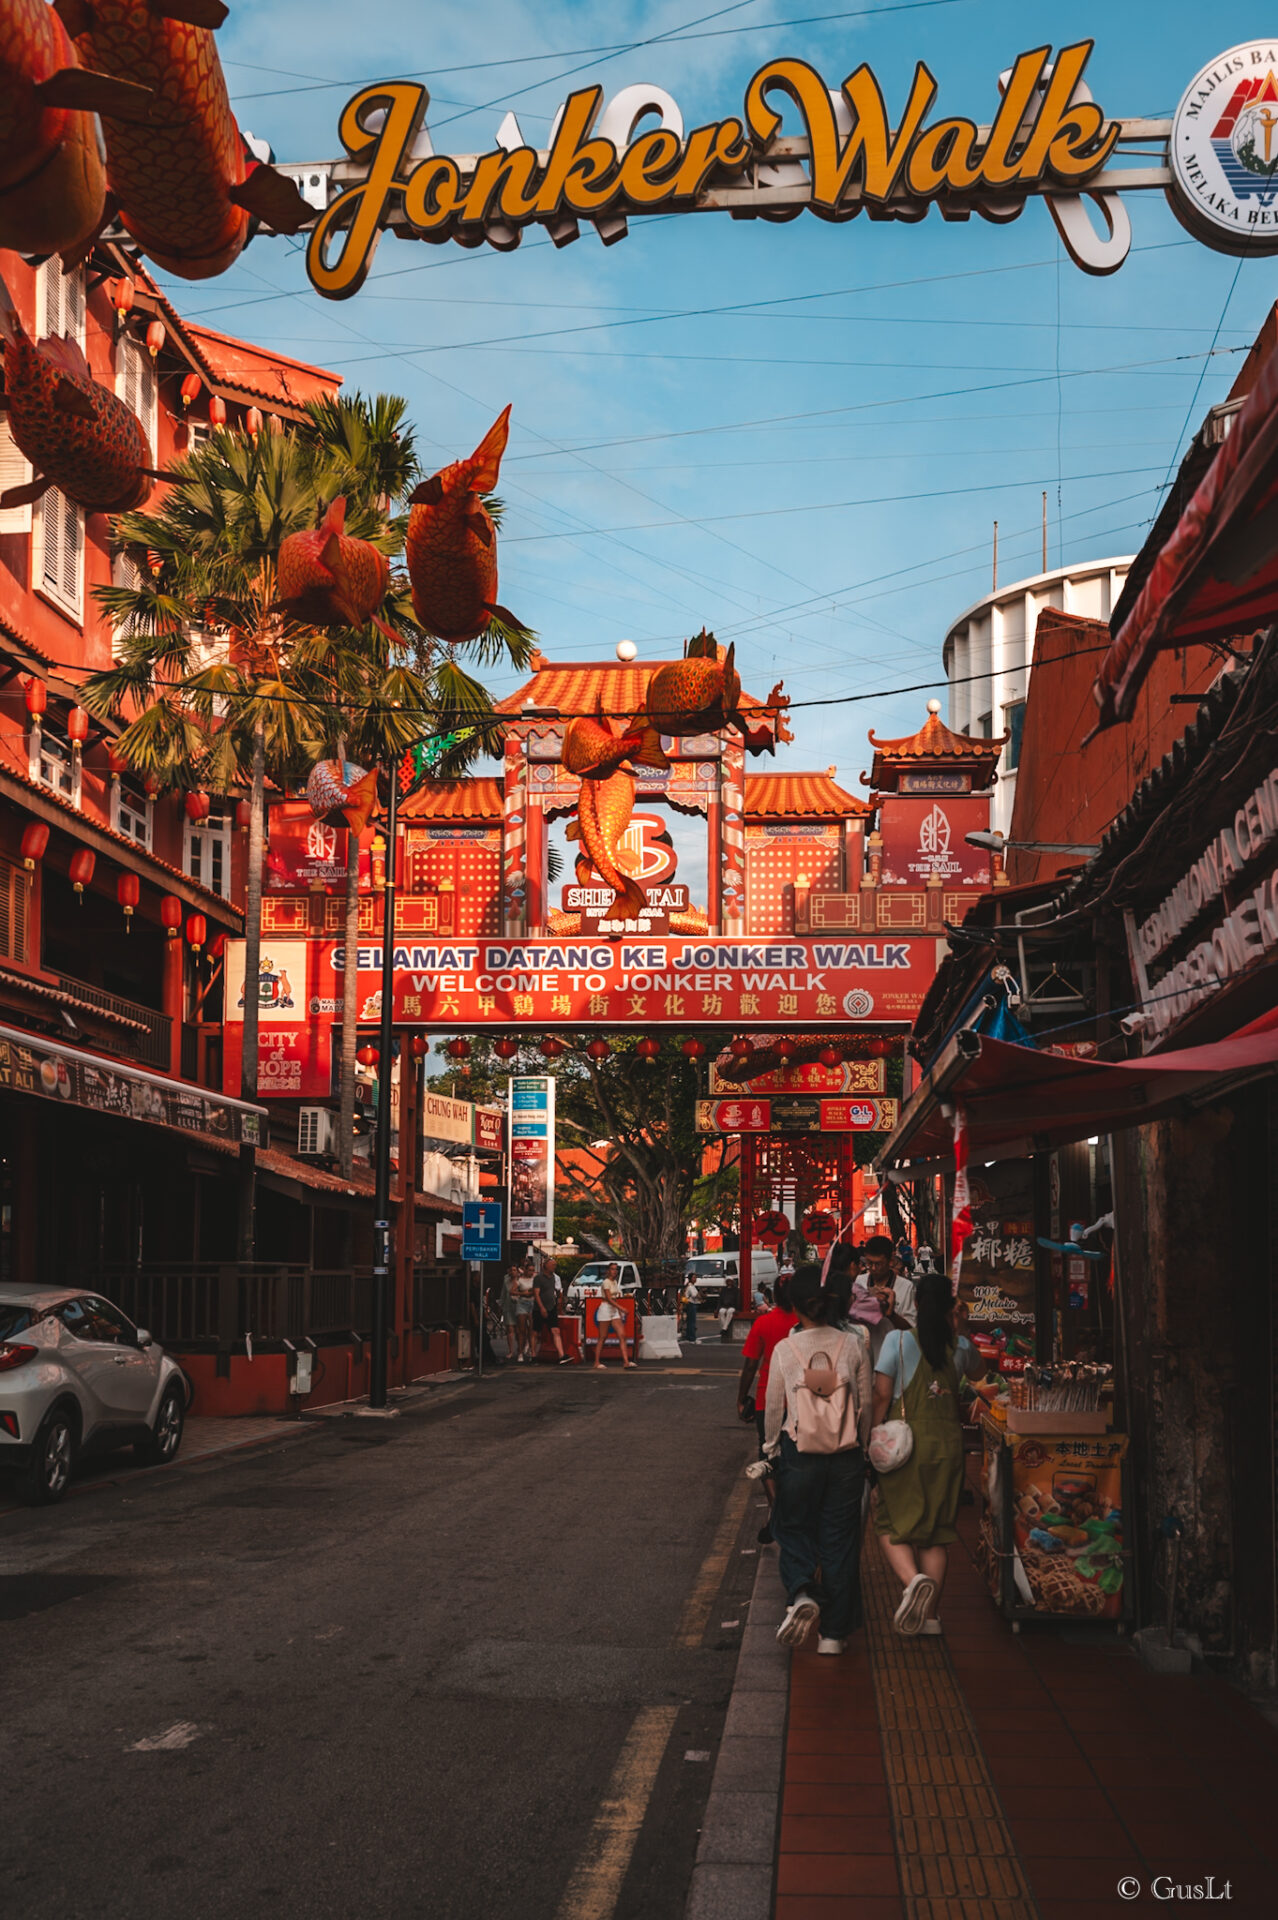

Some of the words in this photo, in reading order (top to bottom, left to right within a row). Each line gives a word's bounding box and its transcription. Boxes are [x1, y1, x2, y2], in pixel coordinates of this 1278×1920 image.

[1186, 56, 1244, 120] MAJLIS
[305, 82, 749, 300] Jonker
[745, 40, 1121, 210] Walk
[1183, 153, 1240, 220] MELAKA
[319, 866, 348, 878] SAIL
[931, 861, 963, 873] SAIL
[646, 888, 684, 907] TAI
[1212, 898, 1264, 981] ONE
[330, 946, 478, 971] SELAMAT
[486, 946, 613, 970] DATANG
[620, 945, 667, 969] KE
[675, 945, 807, 969] JONKER
[814, 944, 910, 969] WALK
[412, 974, 560, 992] WELCOME
[568, 974, 606, 992] TO
[614, 973, 733, 992] JONKER
[741, 973, 827, 992] WALK
[257, 1032, 299, 1047] CITY
[270, 1047, 286, 1060] of
[15, 1071, 34, 1089] ALI
[427, 1097, 451, 1119] CHUNG
[453, 1104, 468, 1122] WAH
[851, 1106, 872, 1116] G.L.
[971, 1237, 1033, 1269] 椰糖
[973, 1285, 1000, 1297] 100%
